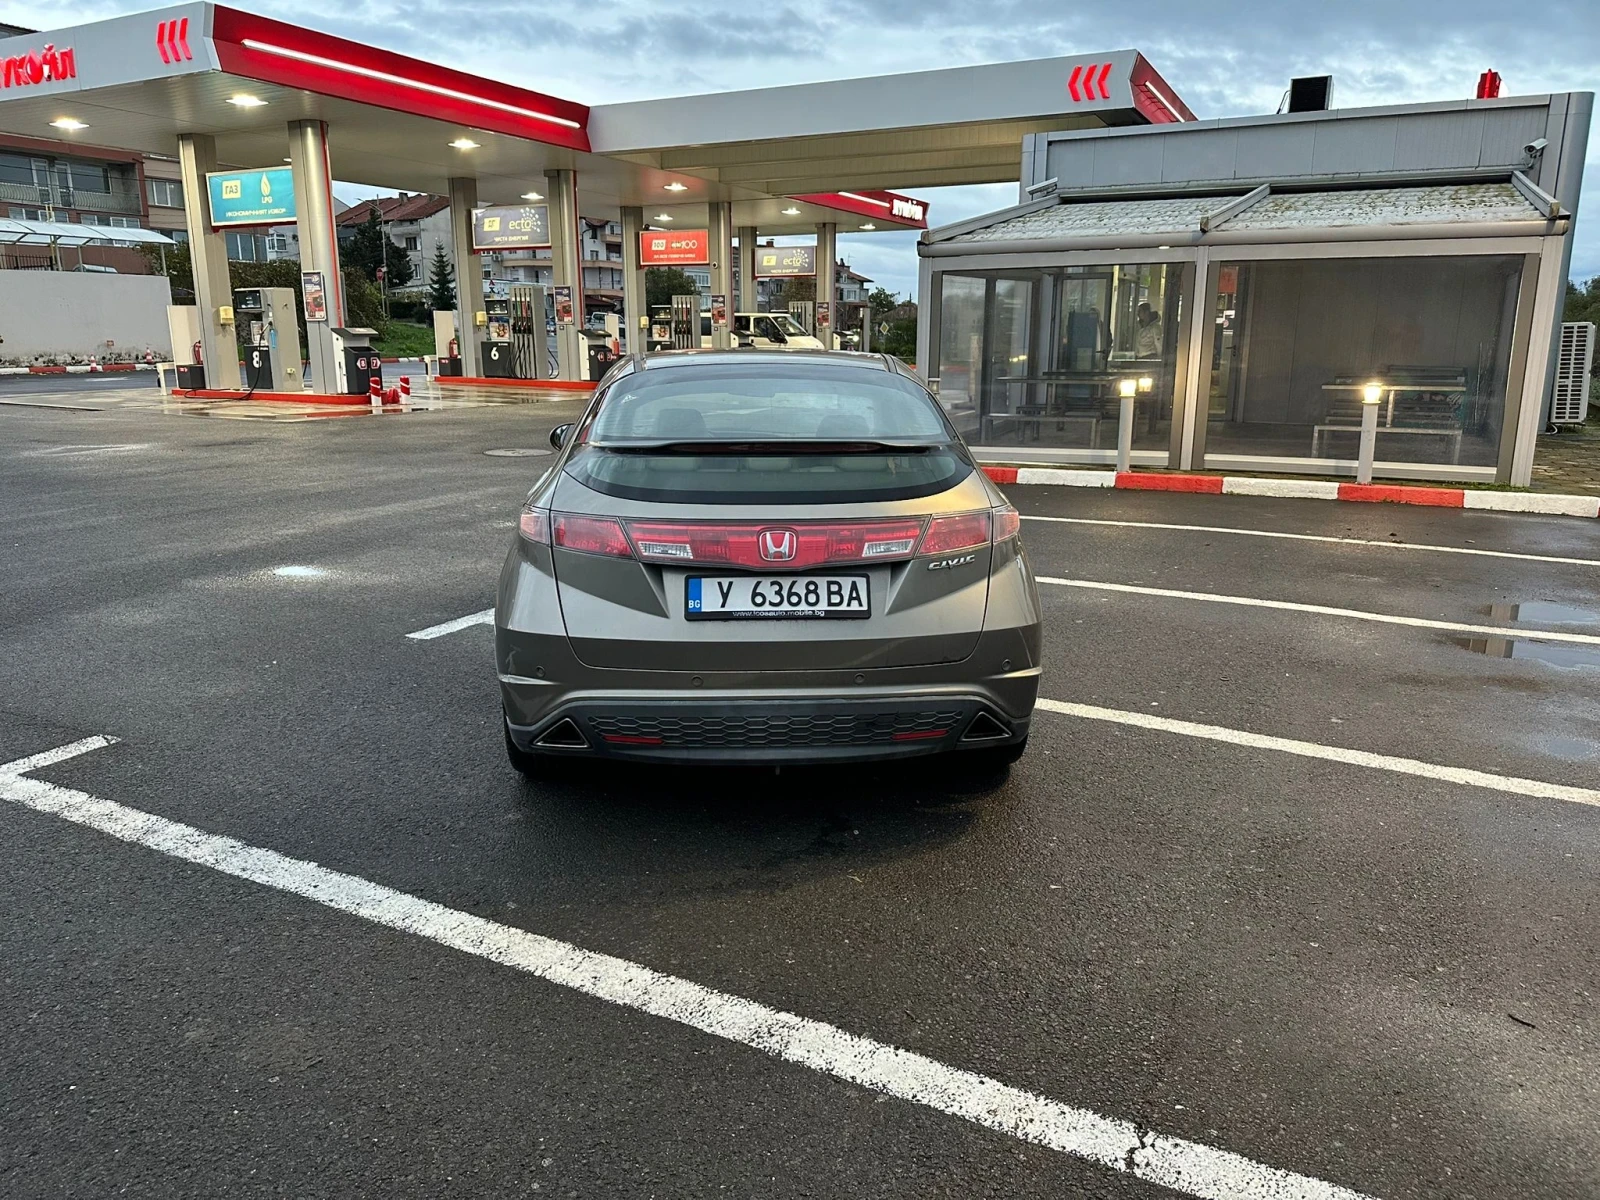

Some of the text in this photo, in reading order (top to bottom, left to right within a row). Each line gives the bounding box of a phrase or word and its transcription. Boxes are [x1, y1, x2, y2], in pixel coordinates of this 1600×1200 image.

[0, 44, 76, 88] УКОЙЛ
[225, 184, 239, 195] ГАЗ
[261, 196, 273, 204] LPG
[508, 217, 532, 230] ecto
[783, 256, 802, 265] ecto
[252, 350, 262, 368] 8
[490, 346, 499, 361] 6
[927, 554, 976, 571] CIVIC
[750, 580, 821, 608] 6368
[688, 600, 701, 609] BG
